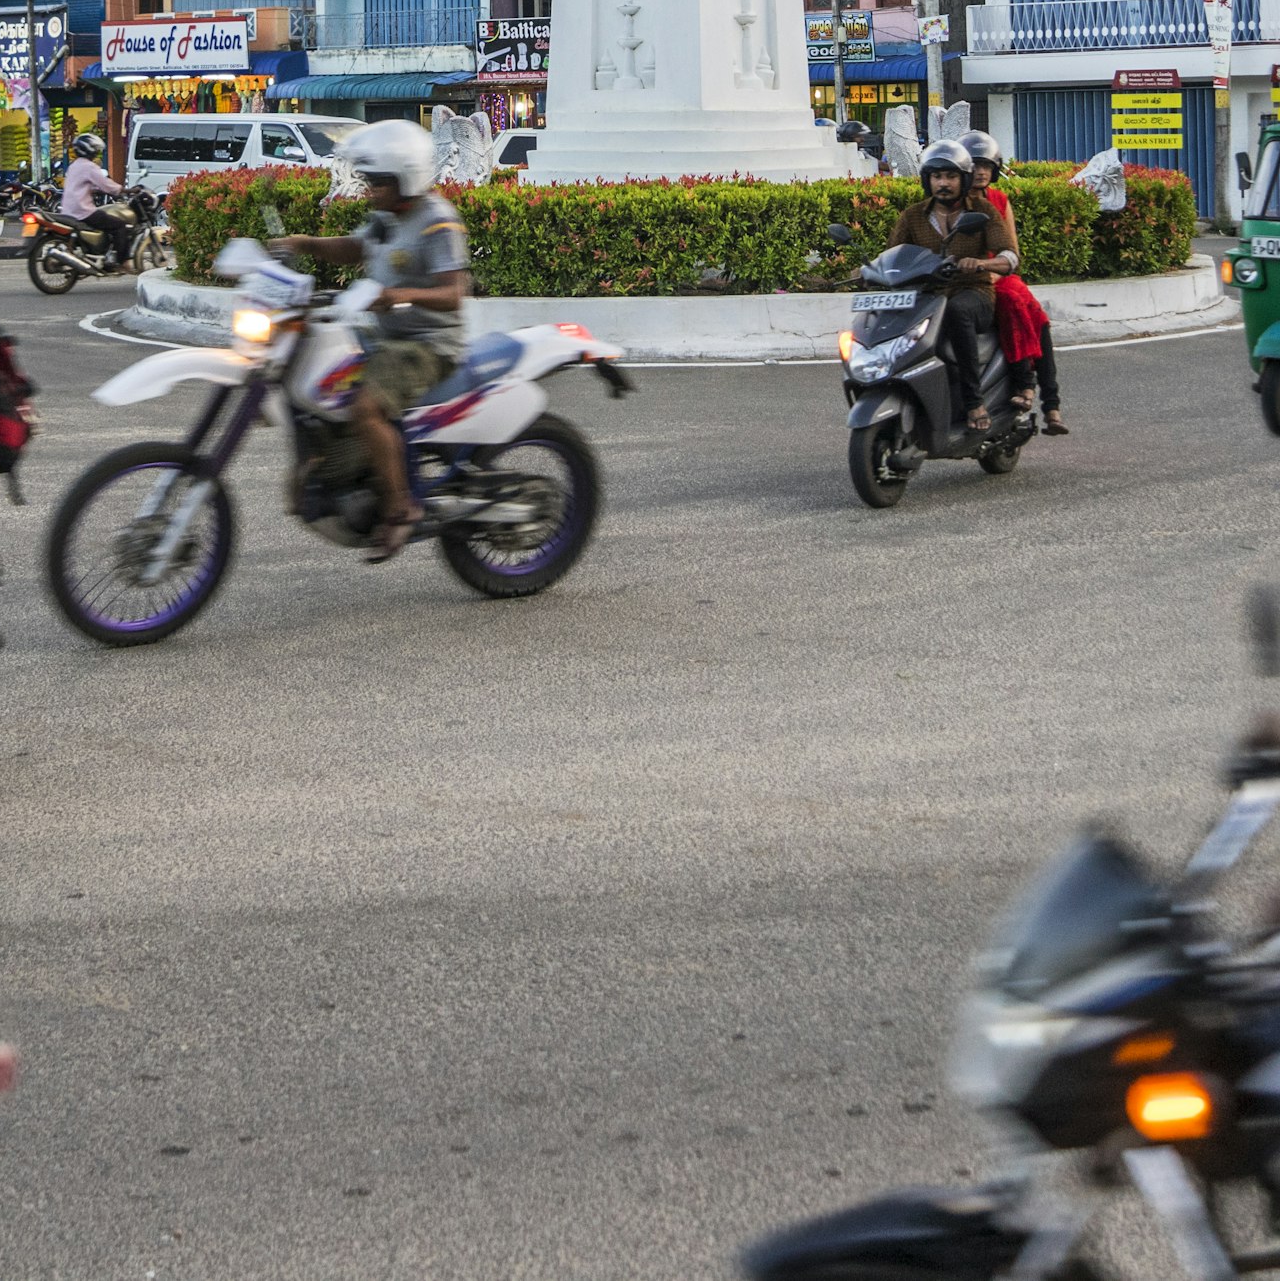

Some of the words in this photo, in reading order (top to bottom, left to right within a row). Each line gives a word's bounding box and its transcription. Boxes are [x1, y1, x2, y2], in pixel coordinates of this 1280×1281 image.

[499, 20, 551, 40] Battica
[106, 27, 156, 61] House
[160, 25, 177, 64] of
[177, 24, 242, 60] Fashion
[1, 56, 46, 72] KANA
[864, 293, 913, 308] BFF6716
